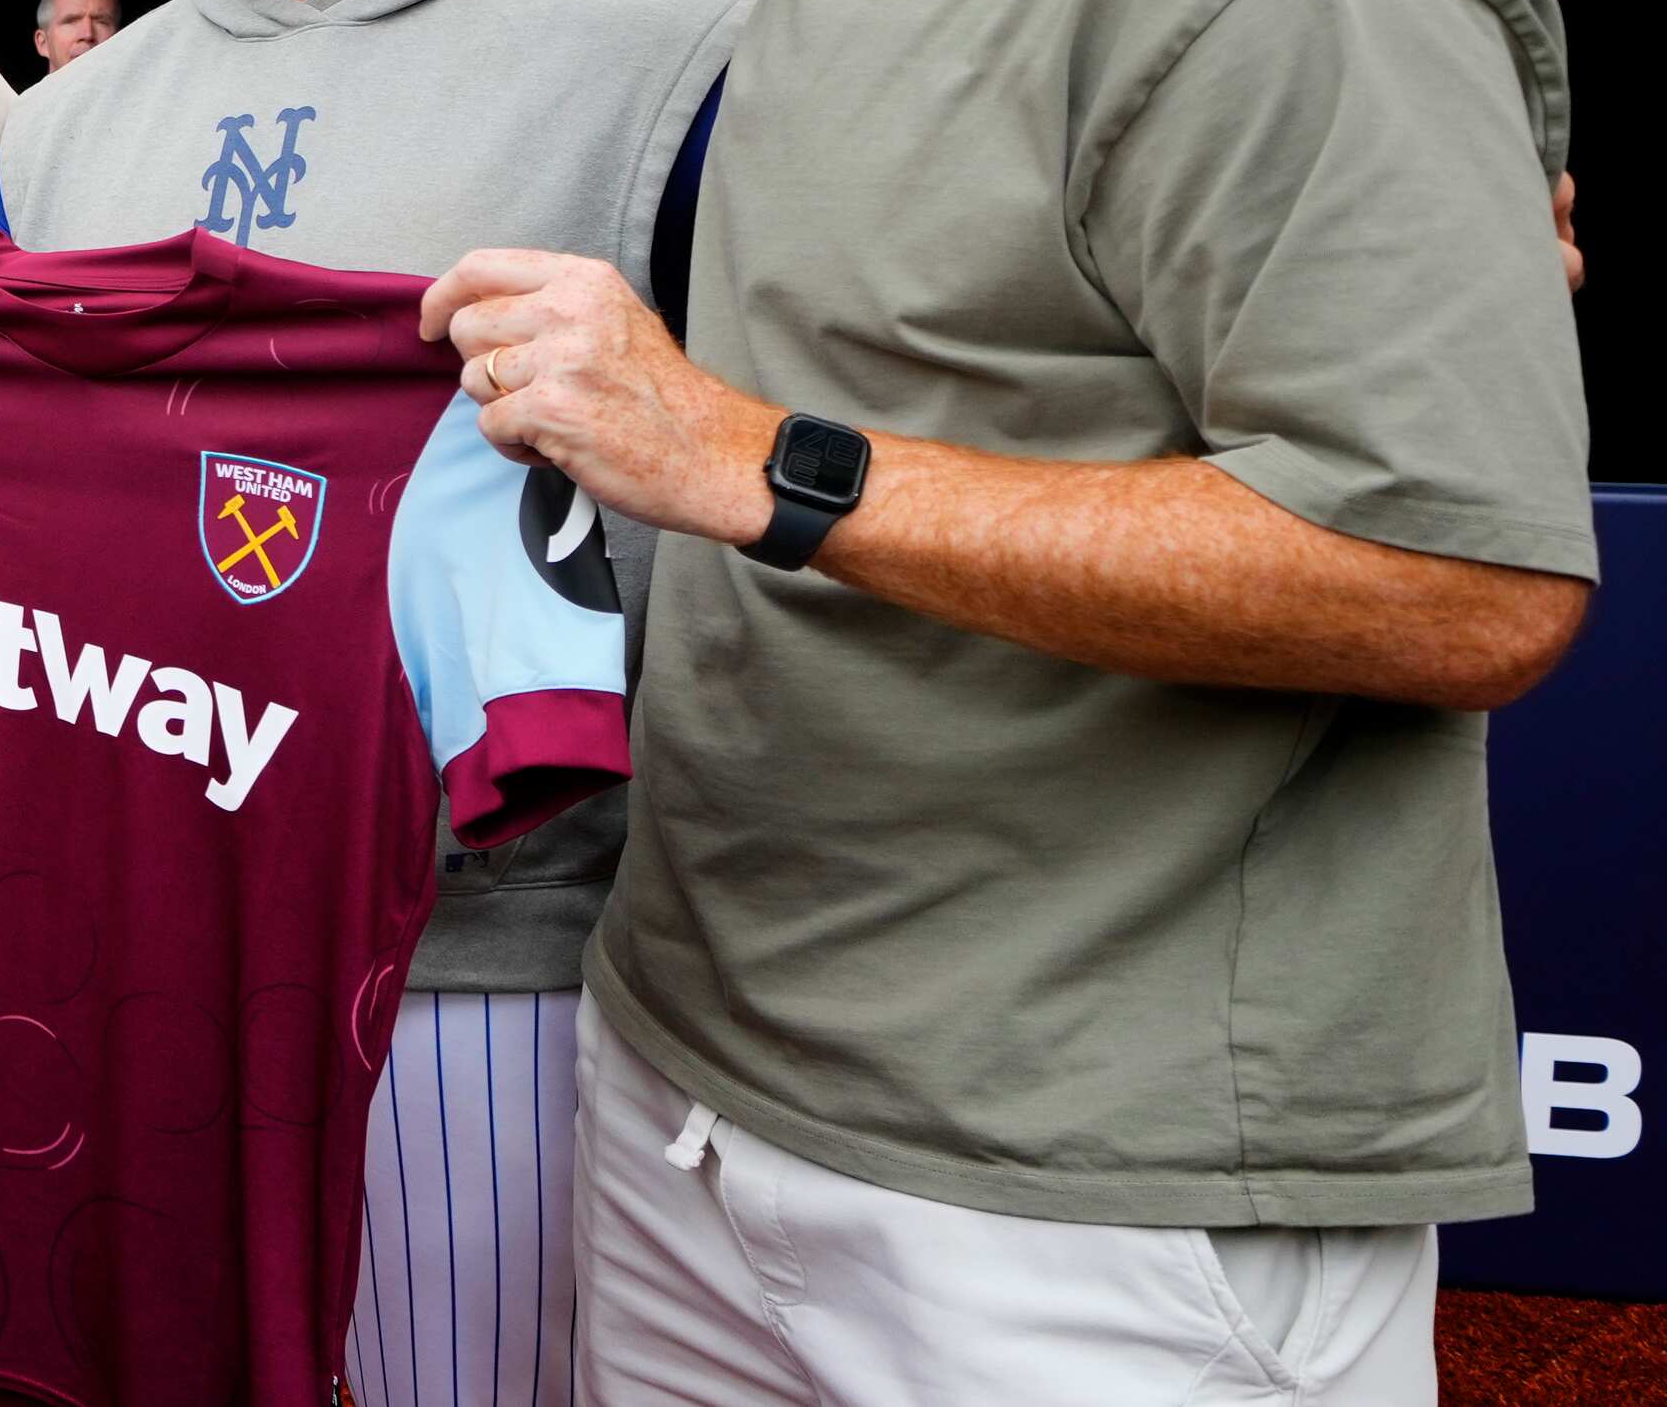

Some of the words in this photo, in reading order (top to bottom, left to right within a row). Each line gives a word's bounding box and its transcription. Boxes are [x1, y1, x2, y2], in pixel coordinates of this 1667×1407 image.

[215, 463, 266, 484] WEST
[268, 472, 313, 498] HAM
[235, 480, 291, 503] UNITED
[227, 575, 267, 595] LONDON
